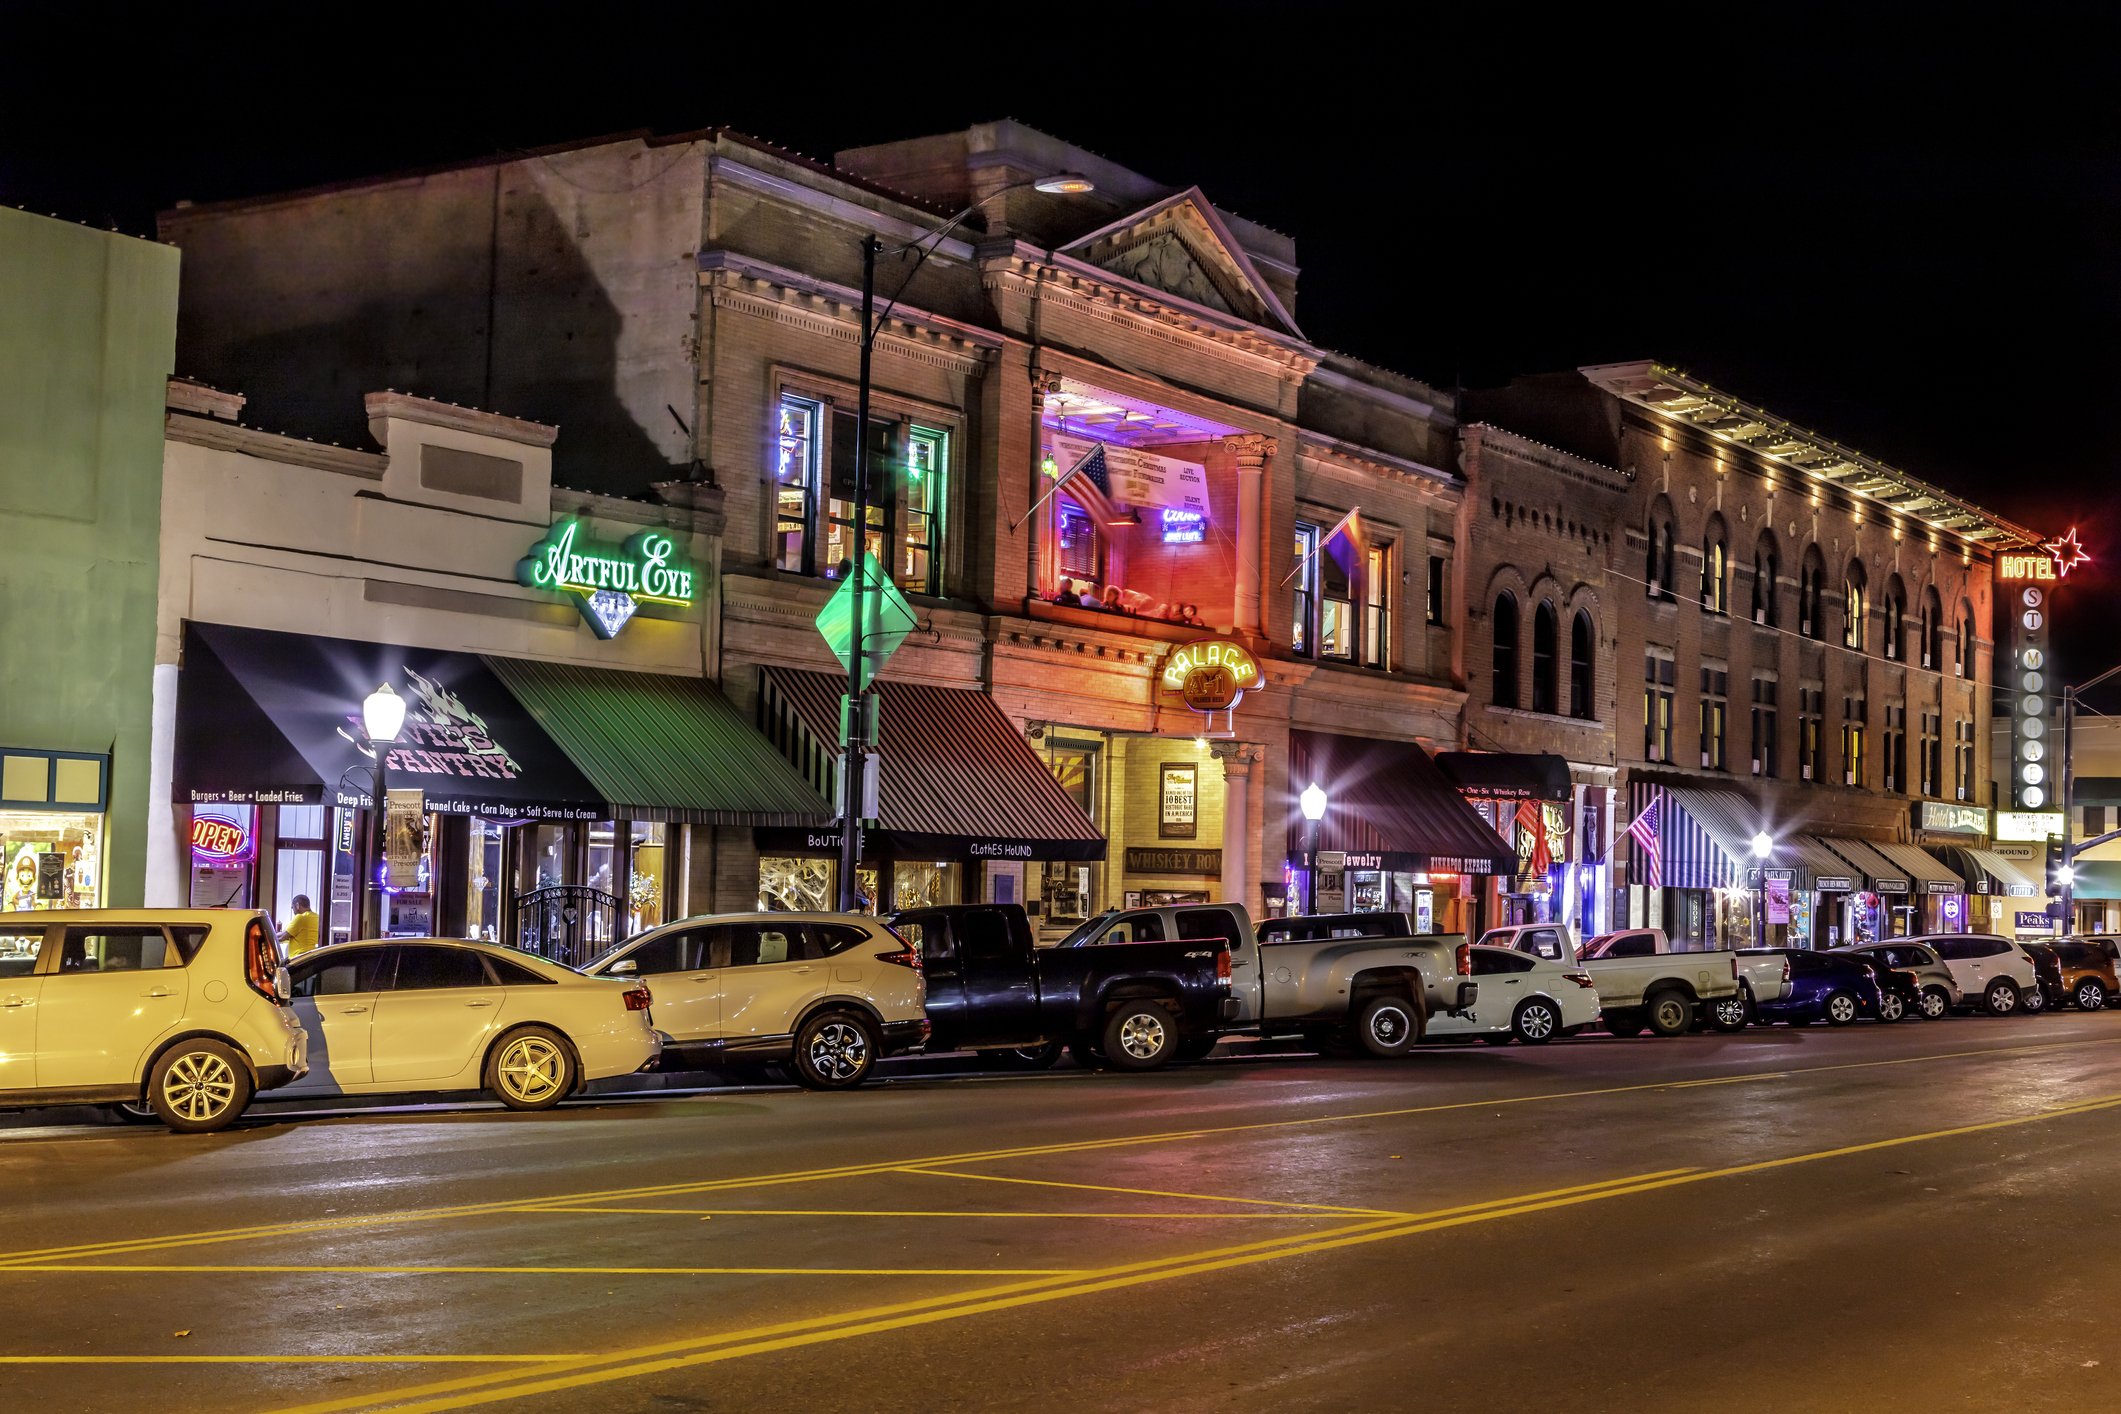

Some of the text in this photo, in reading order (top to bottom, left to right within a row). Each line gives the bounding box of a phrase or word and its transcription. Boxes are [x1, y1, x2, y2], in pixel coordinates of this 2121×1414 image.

[534, 522, 692, 598] ARTFUL EYE
[2002, 556, 2056, 579] HOTEL
[1165, 646, 1254, 683] PALACE
[1187, 674, 1226, 695] A-1
[2026, 652, 2039, 804] MICHAEL
[191, 790, 304, 803] Burgers Beer Loaded Fries
[337, 792, 373, 807] Deep Fri
[1165, 796, 1193, 804] 10 BEST
[1494, 788, 1516, 797] Whiskey
[389, 801, 421, 810] Prescott
[425, 799, 596, 819] Funnel Cake Corn Dogs Soft Serve Ice Cream
[1926, 806, 1949, 827] Hotel
[1958, 810, 1985, 831] MICHAEL
[193, 818, 242, 855] OPEN
[1129, 853, 1222, 870] WHISKEY ROW
[1343, 854, 1382, 869] Jewelry
[1464, 858, 1492, 874] EXPRESS
[2020, 914, 2050, 924] Peaks
